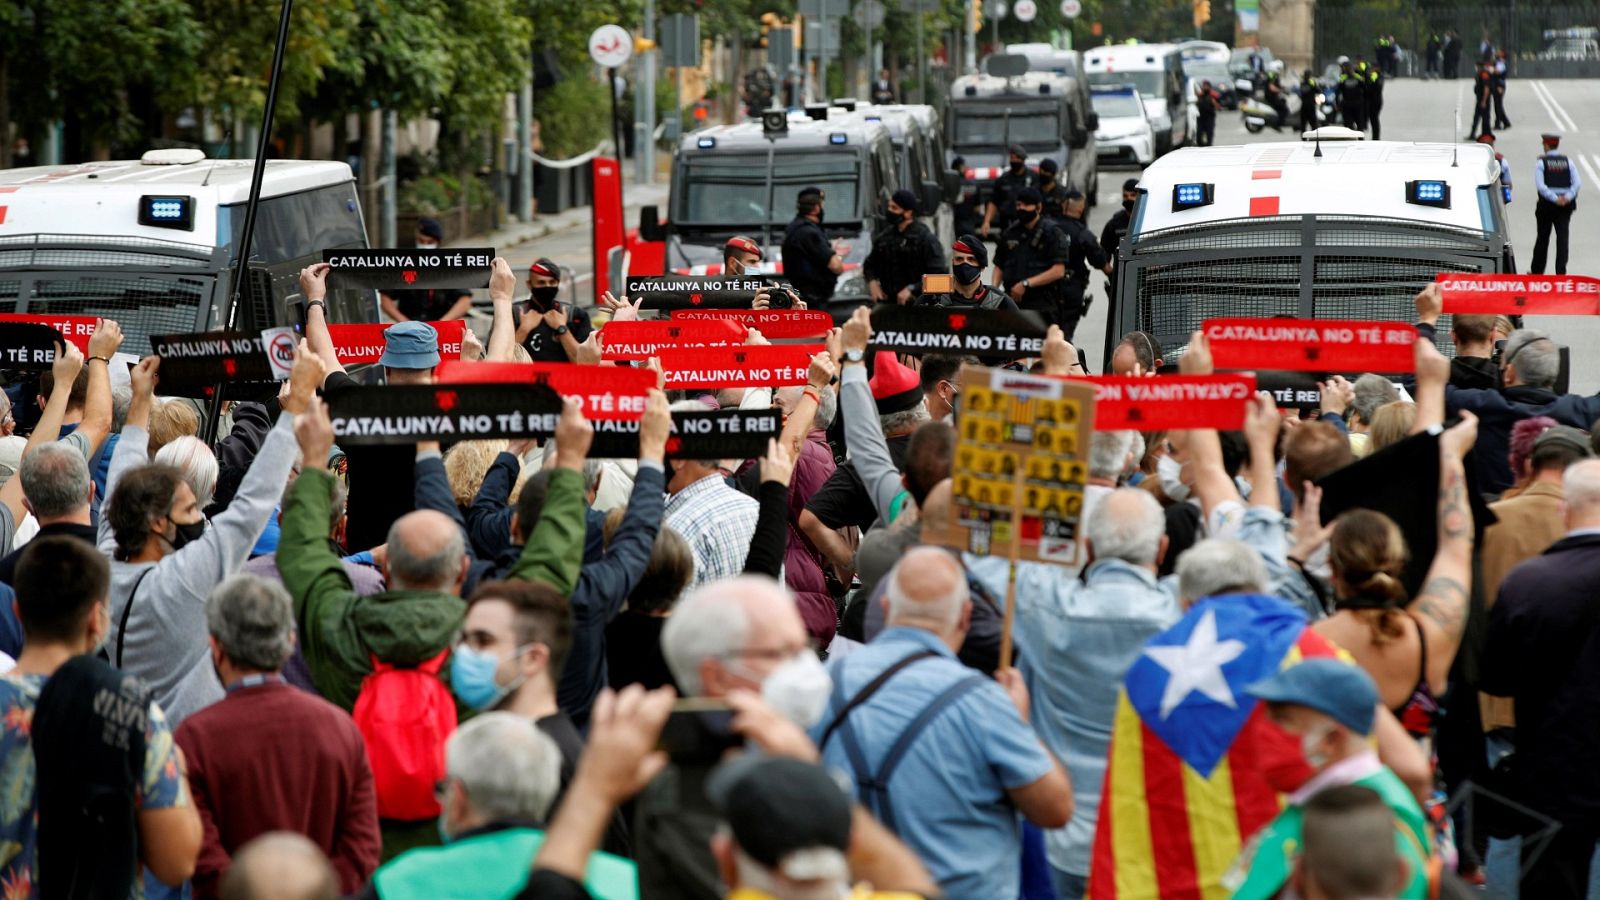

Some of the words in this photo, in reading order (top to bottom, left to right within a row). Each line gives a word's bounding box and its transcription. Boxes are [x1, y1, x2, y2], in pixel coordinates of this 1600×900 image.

[329, 256, 414, 268] CATALUNYA
[419, 256, 440, 267] NO
[445, 252, 462, 267] TÉ
[467, 254, 489, 267] REI
[630, 281, 700, 292] CATALUNYA
[704, 281, 722, 291] NO
[725, 278, 741, 291] TÉ
[744, 280, 762, 290] REI
[1440, 279, 1526, 292] CATALUNYA
[1528, 281, 1552, 292] NO
[1554, 279, 1574, 293] TÉ
[676, 312, 757, 324] CATALUNYA
[760, 314, 779, 323] NO
[783, 311, 800, 321] TÉ
[804, 313, 826, 321] REI
[53, 320, 71, 335] TÉ
[76, 324, 95, 335] RE
[1207, 325, 1320, 342] CATALUNYA
[1323, 328, 1353, 343] NO
[1357, 327, 1382, 344] TÉ
[158, 340, 232, 359] CATALUNYA
[232, 337, 253, 355] NO
[443, 343, 460, 353] RE
[965, 335, 991, 350] NO
[995, 334, 1016, 350] TÉ
[1020, 338, 1045, 351] RE
[7, 346, 28, 362] TÉ
[33, 349, 54, 363] RE
[664, 370, 746, 382] CATALUNYA
[750, 369, 770, 380] NO
[774, 366, 792, 380] TÉ
[1126, 382, 1249, 401] CATALUNYA
[1274, 386, 1293, 402] TÉ
[1296, 390, 1320, 403] REI
[588, 391, 615, 411] TÉ
[333, 415, 455, 435] CATALUNYA
[459, 416, 492, 433] NO
[497, 410, 524, 431] TÉ
[684, 418, 712, 433] NO
[717, 414, 741, 432] TÉ
[745, 416, 776, 431] REI
